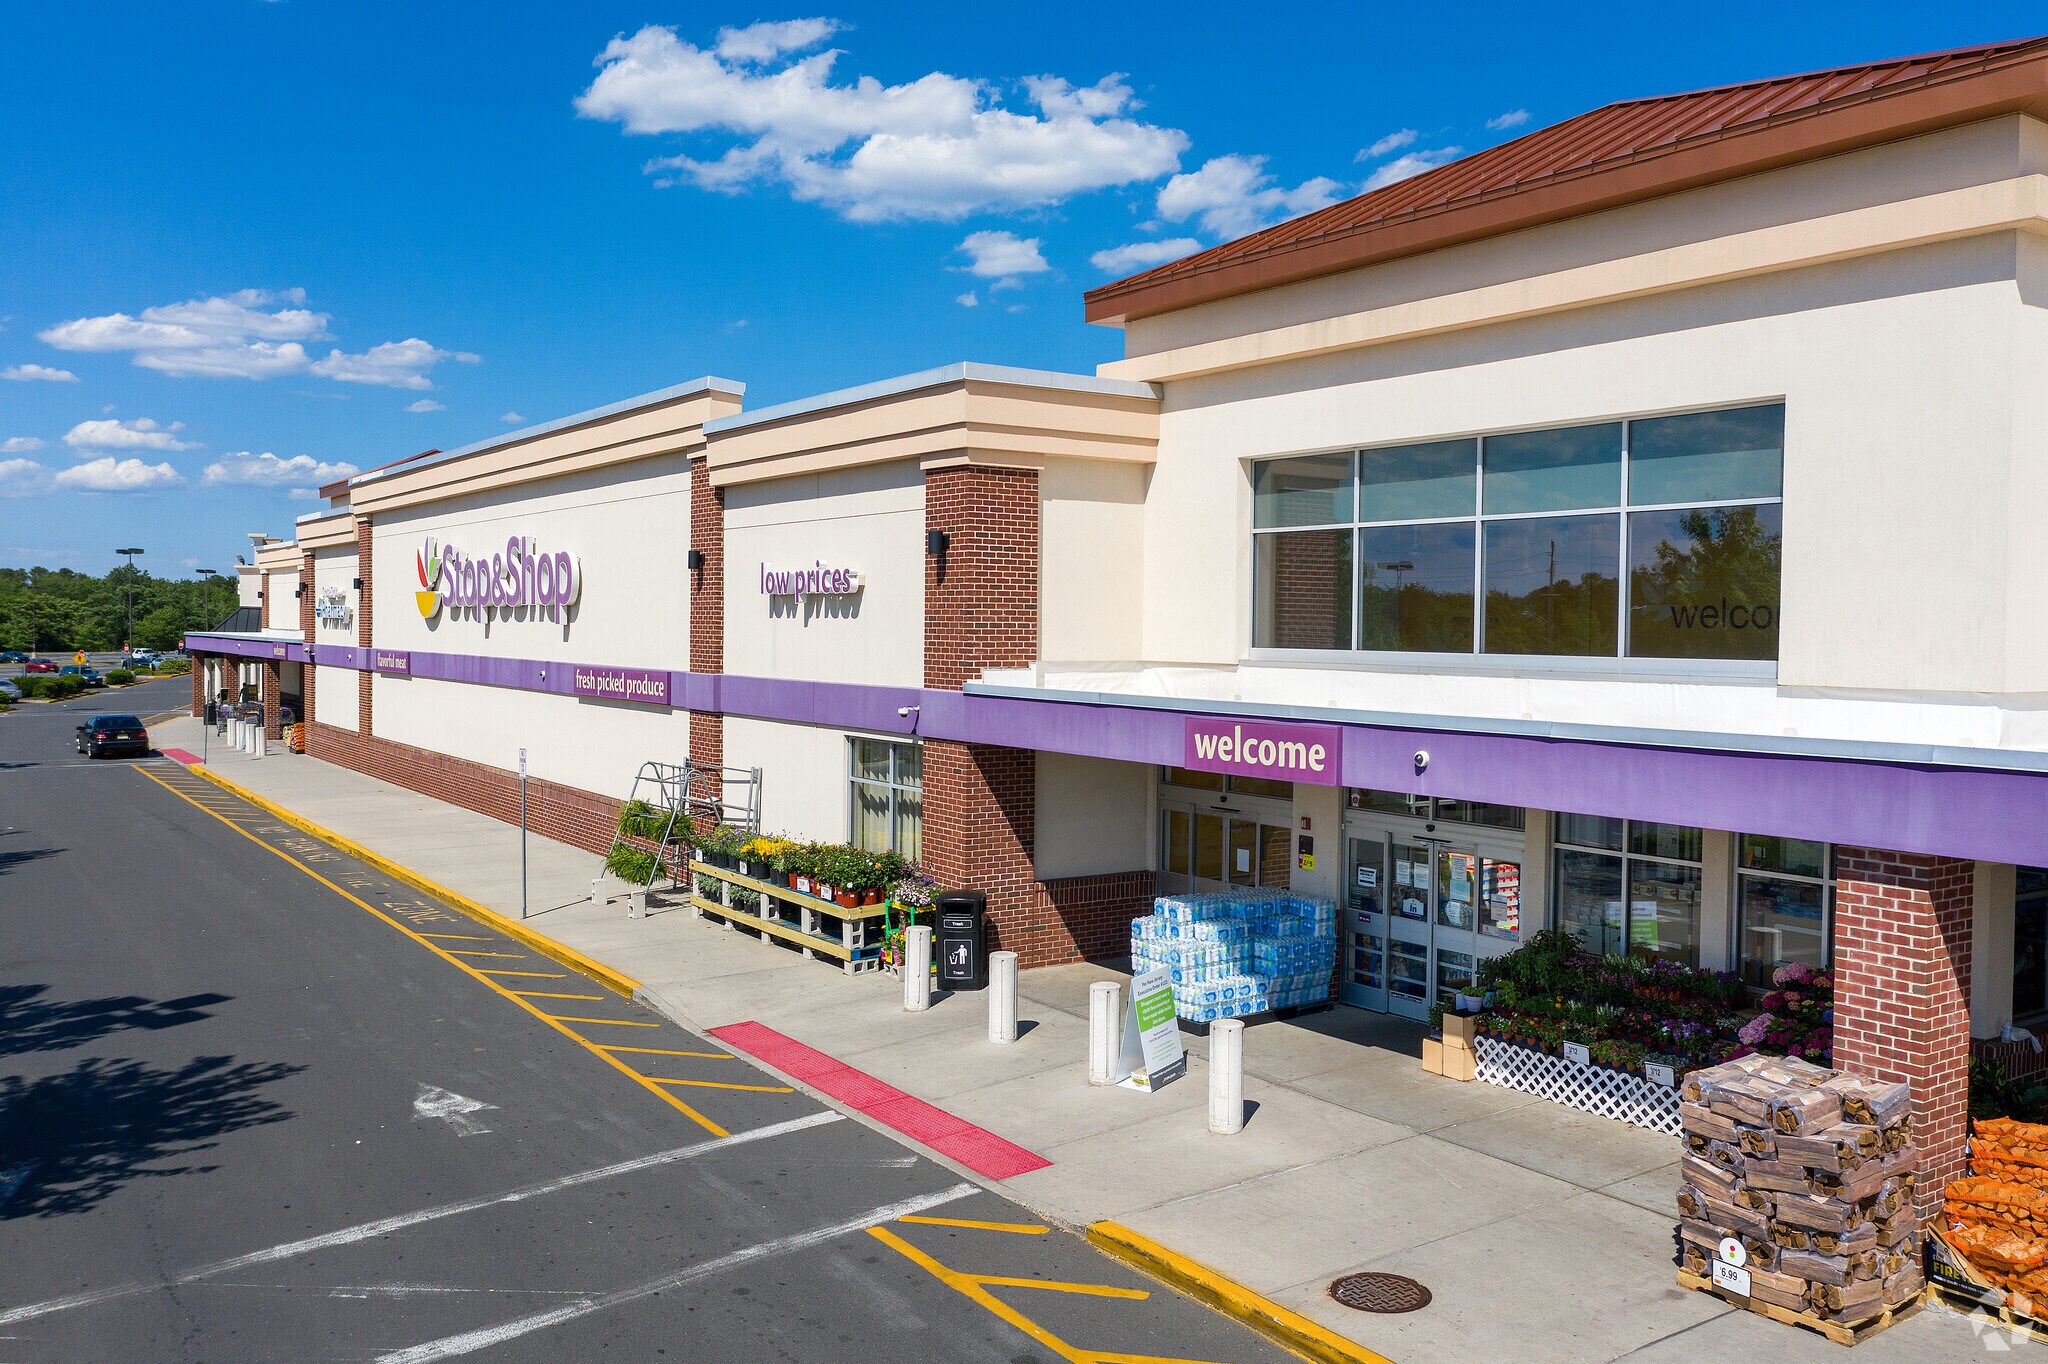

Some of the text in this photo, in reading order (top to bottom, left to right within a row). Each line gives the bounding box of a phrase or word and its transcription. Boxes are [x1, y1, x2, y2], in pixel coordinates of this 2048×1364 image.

[442, 536, 572, 625] Stop&Shop
[760, 559, 851, 604] low prices
[1670, 597, 1780, 629] welco
[395, 657, 407, 669] meat
[576, 668, 664, 699] fresh picked produce
[1194, 725, 1326, 772] welcome
